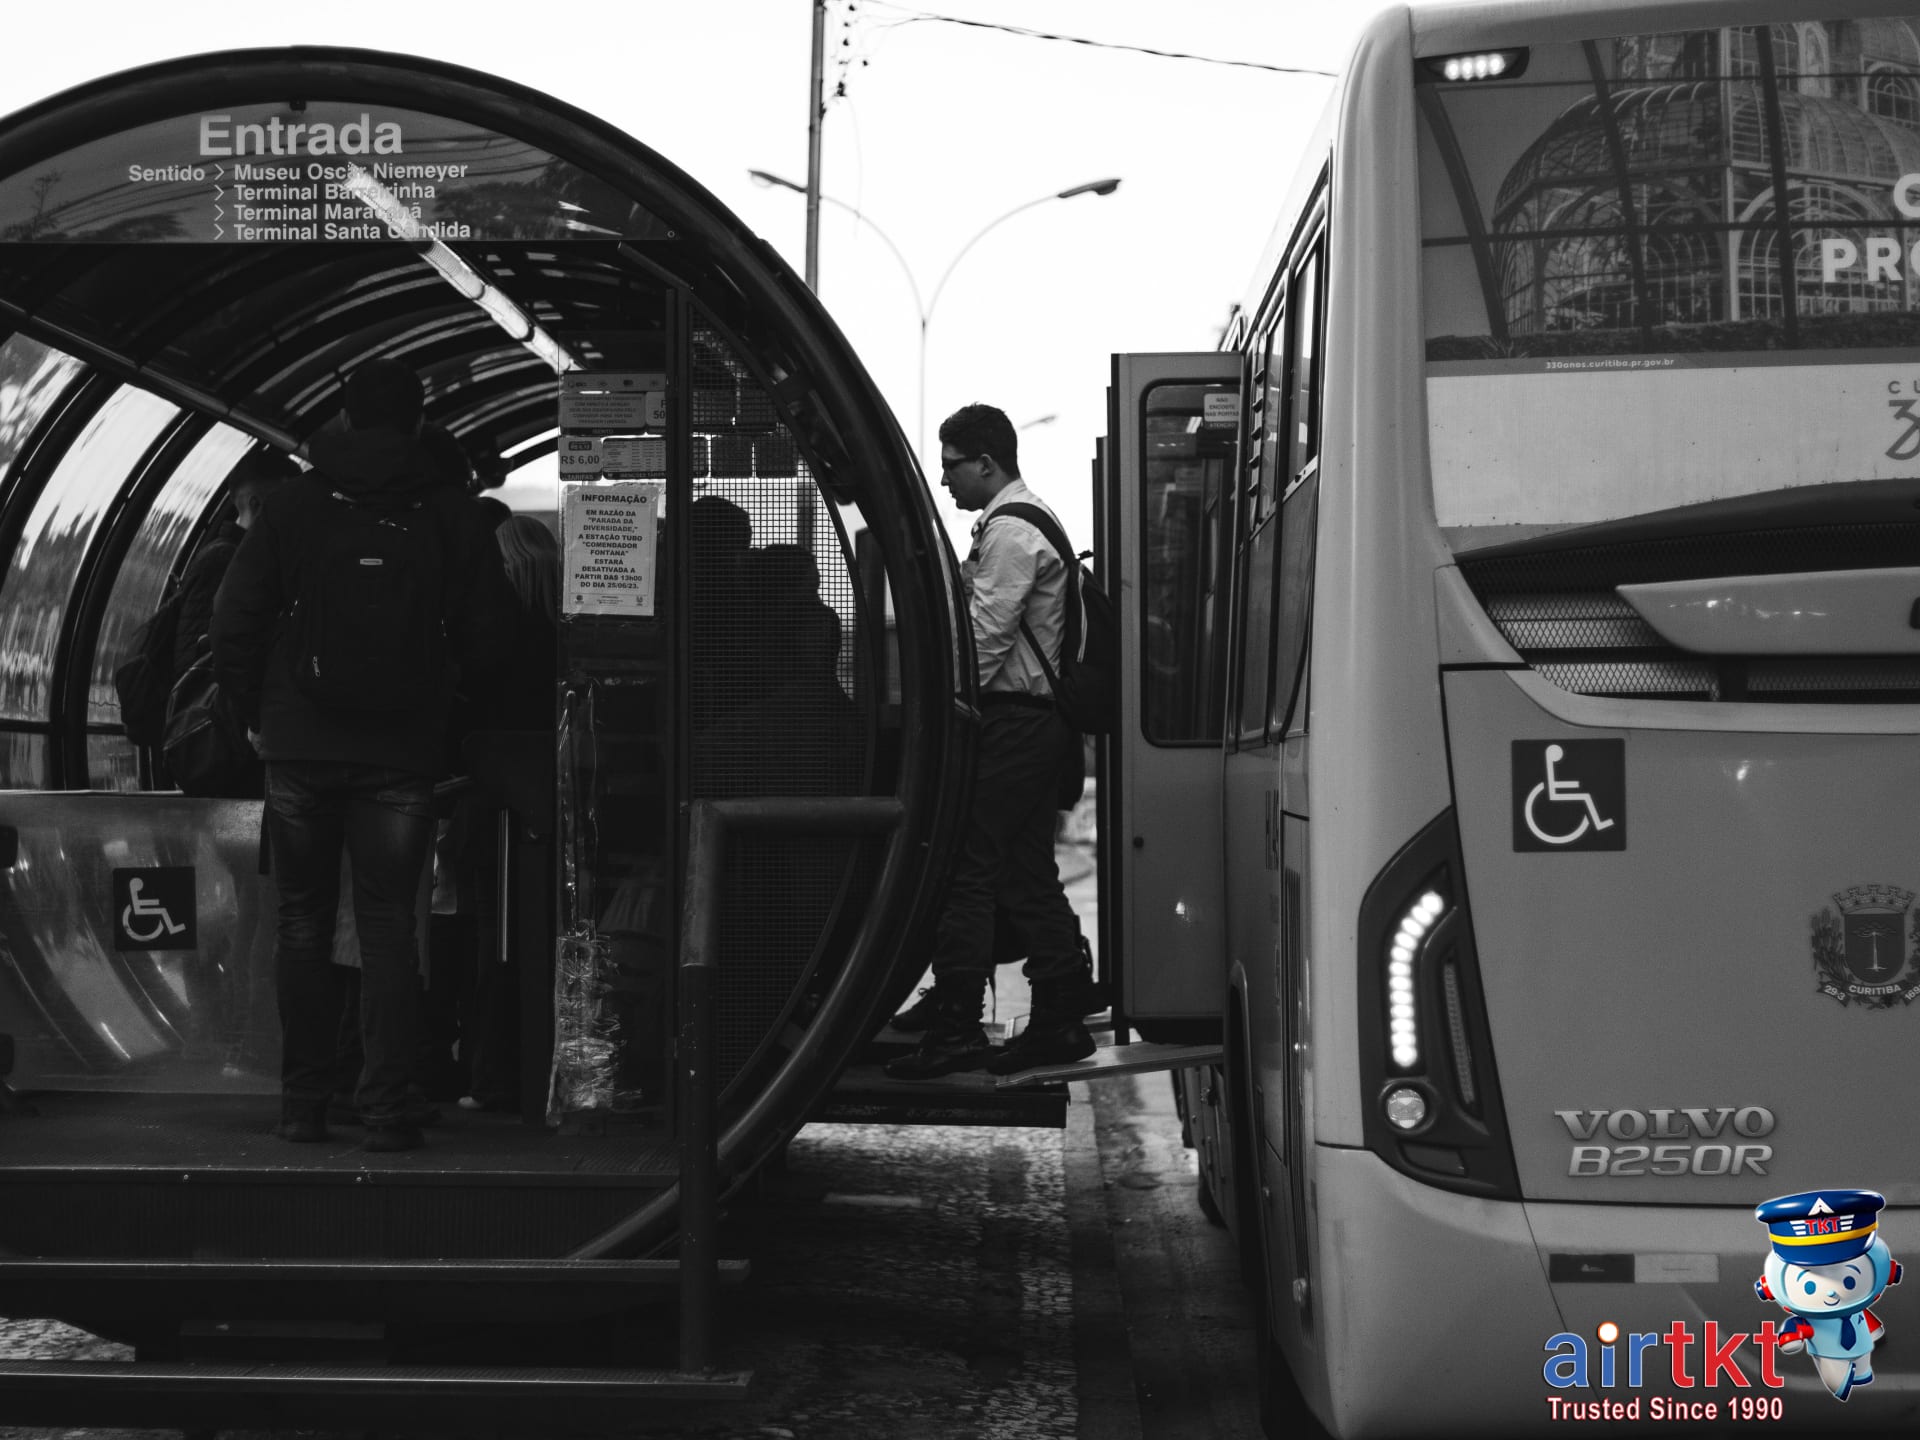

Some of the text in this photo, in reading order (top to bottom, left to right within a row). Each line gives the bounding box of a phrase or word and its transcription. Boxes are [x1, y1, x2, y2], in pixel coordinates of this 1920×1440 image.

[200, 113, 403, 156] Entrada
[128, 162, 468, 182] Sentido Museu Oscar Niemeyer
[233, 184, 318, 201] Terminal
[233, 204, 318, 220] Terminal
[233, 223, 318, 240] Terminal
[324, 222, 381, 240] Santa
[1822, 237, 1920, 283] PR
[581, 494, 647, 504] INFORMAÇÃO
[599, 509, 624, 517] RAZÃO
[586, 534, 620, 542] ESTAÇÃO
[1848, 984, 1902, 996] CURITIBA
[1904, 984, 1920, 1001] 169
[1554, 1106, 1775, 1141] VOLVO
[1567, 1144, 1774, 1178] B250R
